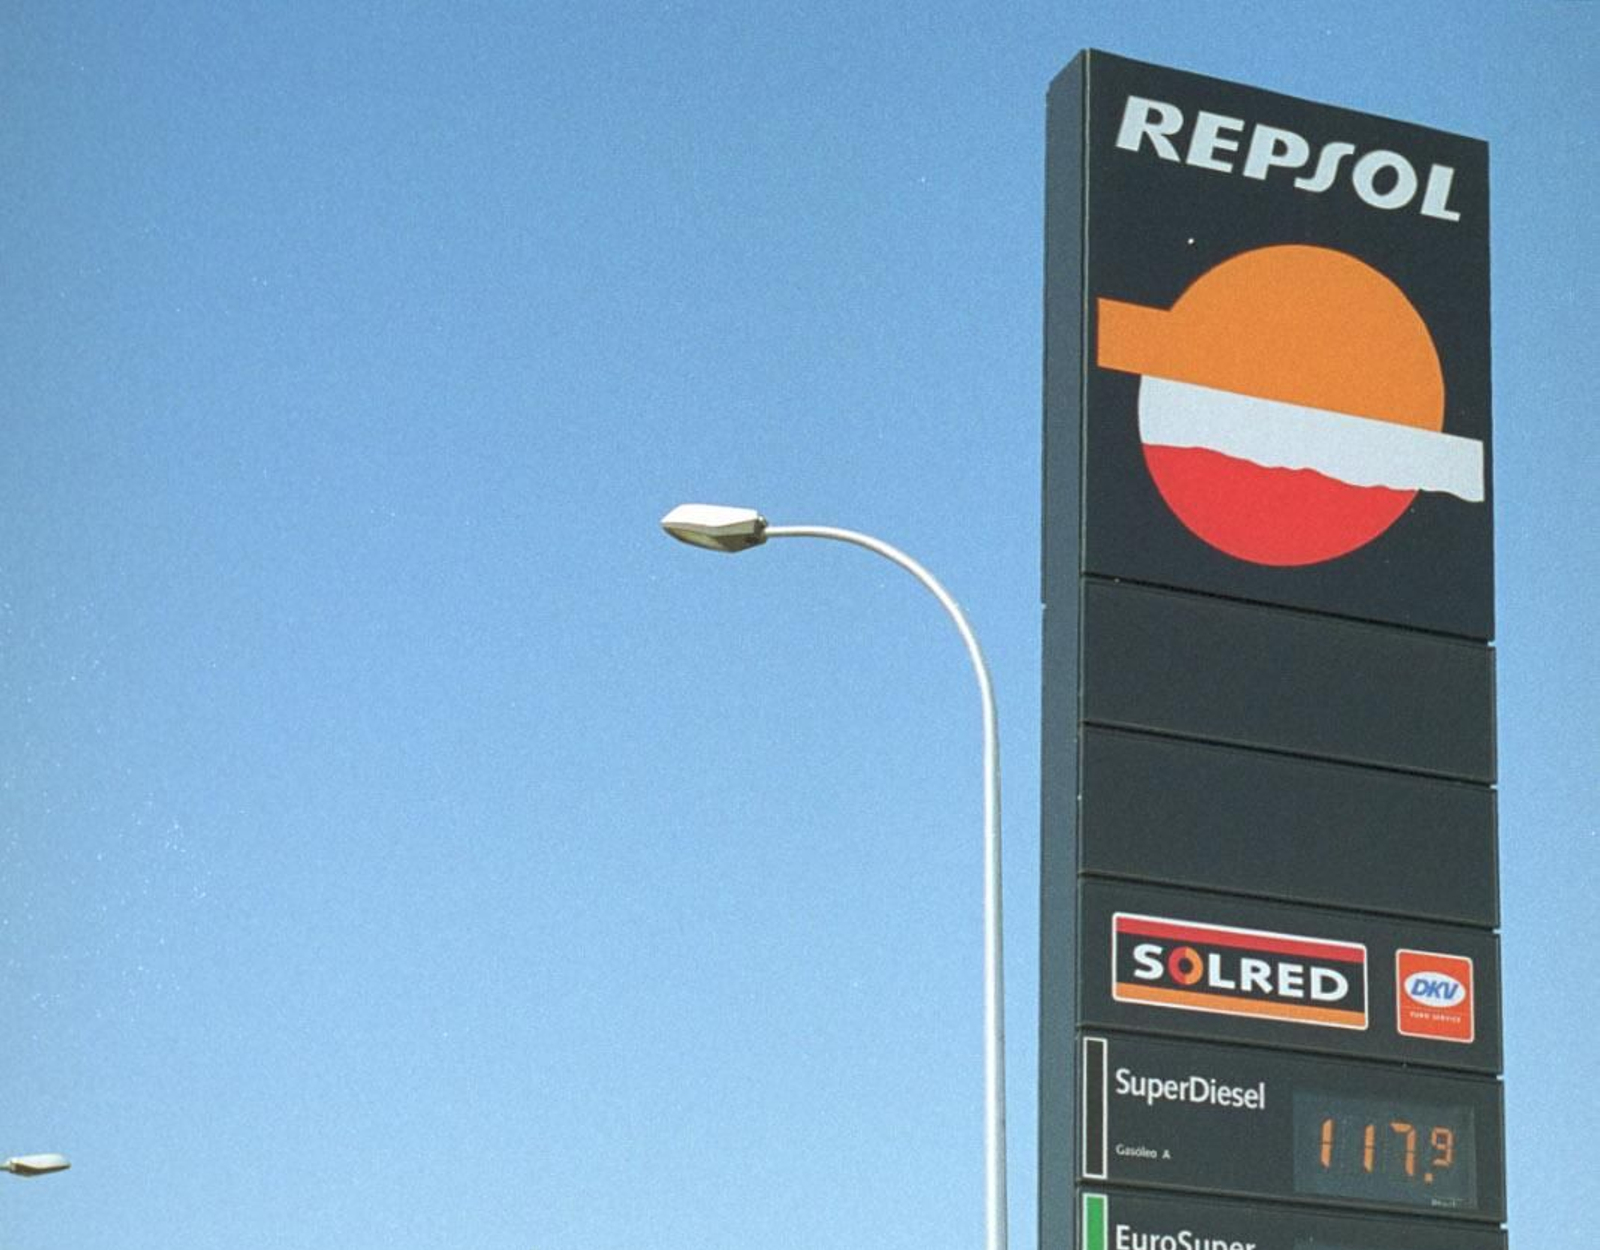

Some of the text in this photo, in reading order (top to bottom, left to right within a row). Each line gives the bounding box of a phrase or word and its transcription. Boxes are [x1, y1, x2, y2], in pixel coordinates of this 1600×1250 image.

[1115, 94, 1461, 223] REPSOL
[1132, 943, 1349, 1002] SOLRED
[1411, 978, 1459, 1000] DKV
[1115, 1068, 1266, 1110] SuperDiesel
[1161, 1149, 1171, 1159] A
